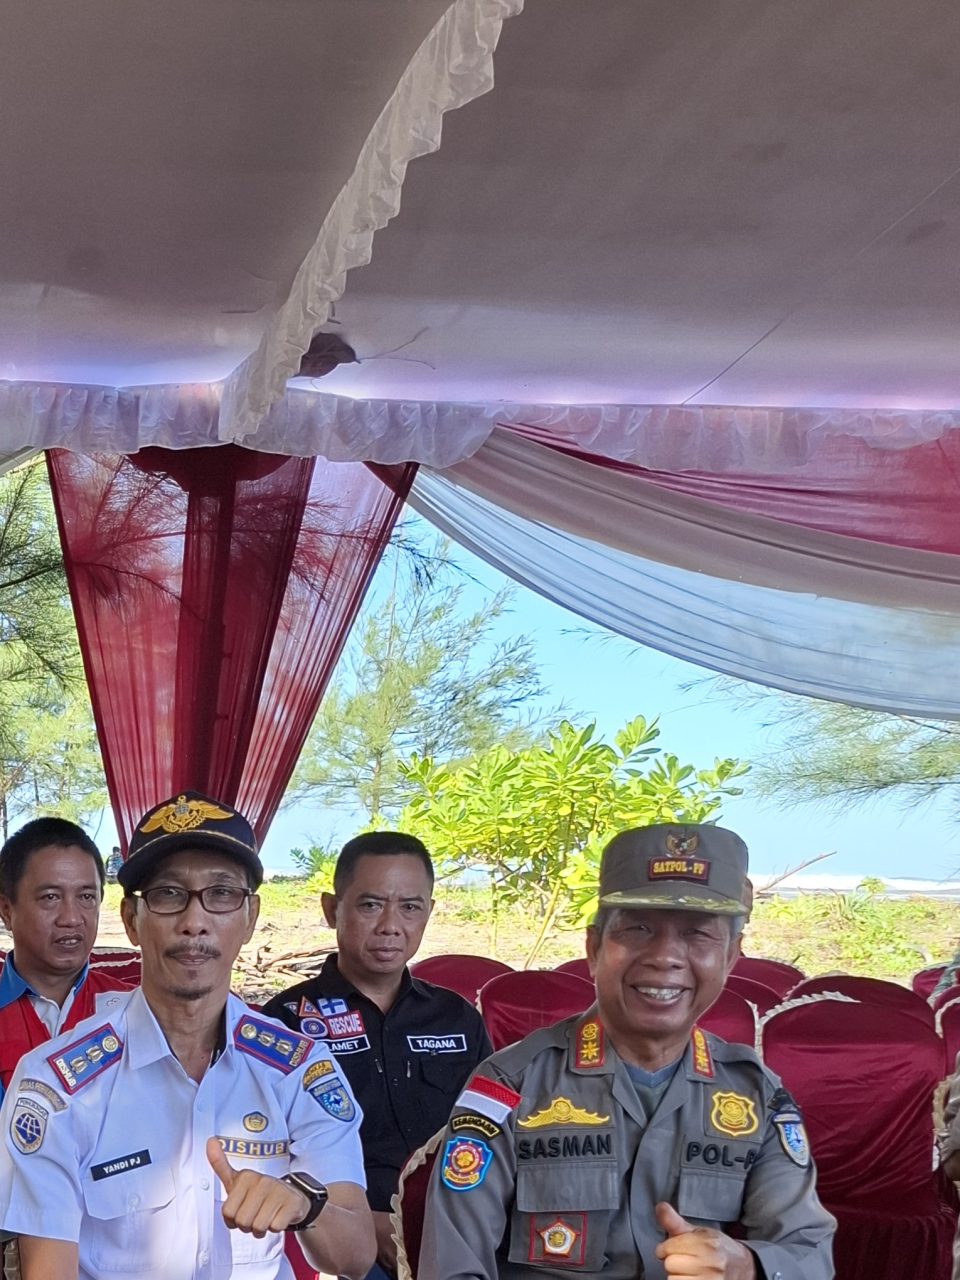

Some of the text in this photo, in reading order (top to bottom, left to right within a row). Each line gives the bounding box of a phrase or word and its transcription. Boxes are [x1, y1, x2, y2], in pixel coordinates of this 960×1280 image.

[328, 1014, 363, 1035] RESCUE
[289, 1040, 308, 1067] DISHUB
[330, 1040, 359, 1051] AMET
[416, 1039, 457, 1049] TAGANA
[55, 1058, 77, 1087] DISHUB
[518, 1133, 612, 1160] SASMAN
[686, 1141, 757, 1170] POL-P
[103, 1156, 141, 1174] YANDI PJ
